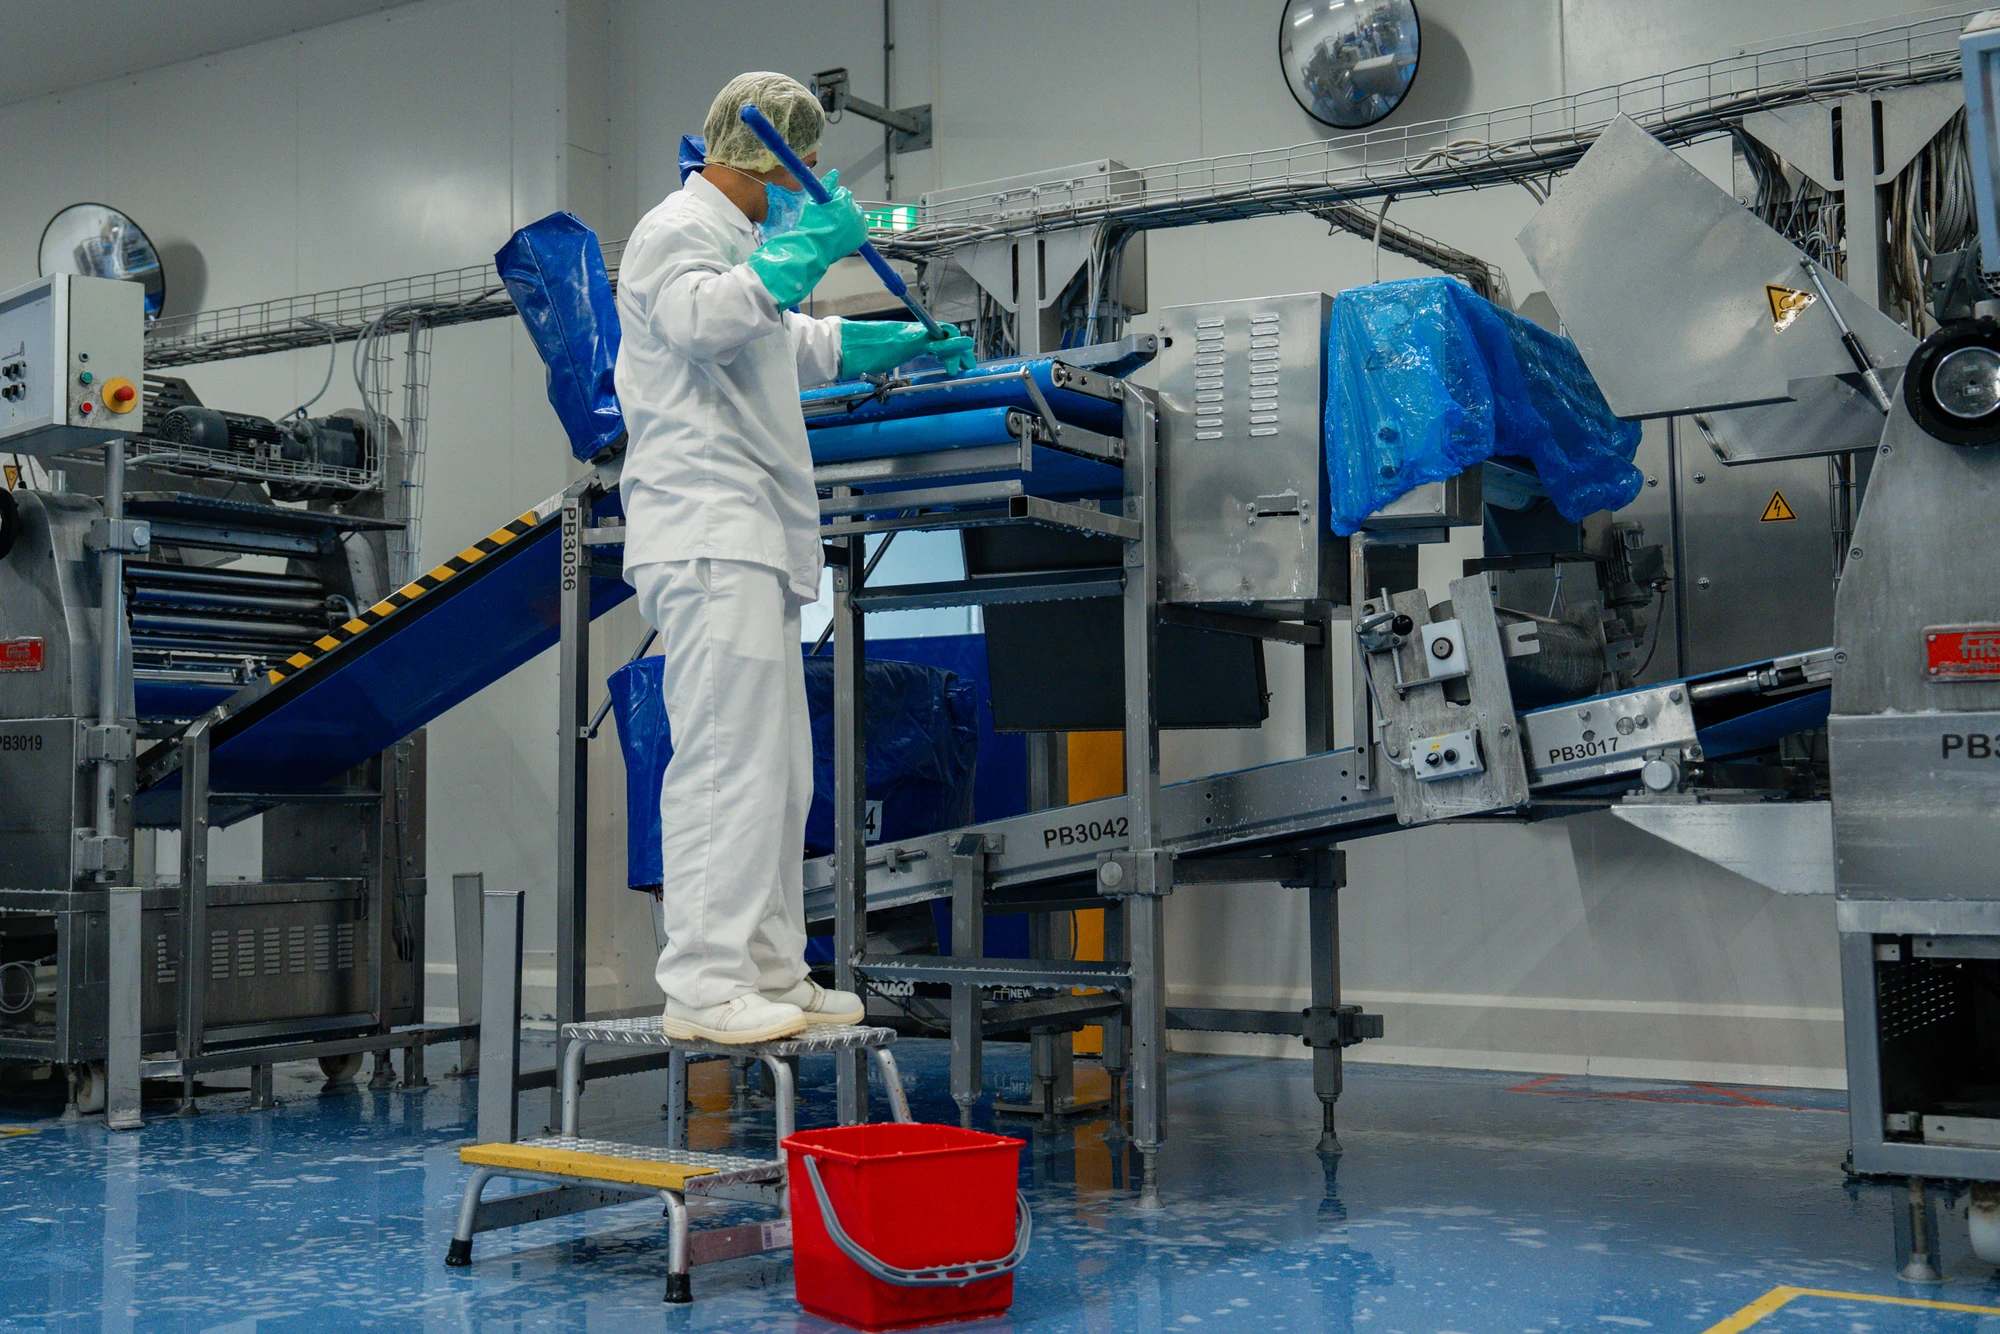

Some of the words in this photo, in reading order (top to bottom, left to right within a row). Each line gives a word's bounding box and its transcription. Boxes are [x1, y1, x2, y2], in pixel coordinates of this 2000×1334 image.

[563, 507, 577, 591] PB3036
[1549, 737, 1618, 764] PB3017
[1942, 734, 2000, 759] PB
[1043, 817, 1129, 849] PB3042
